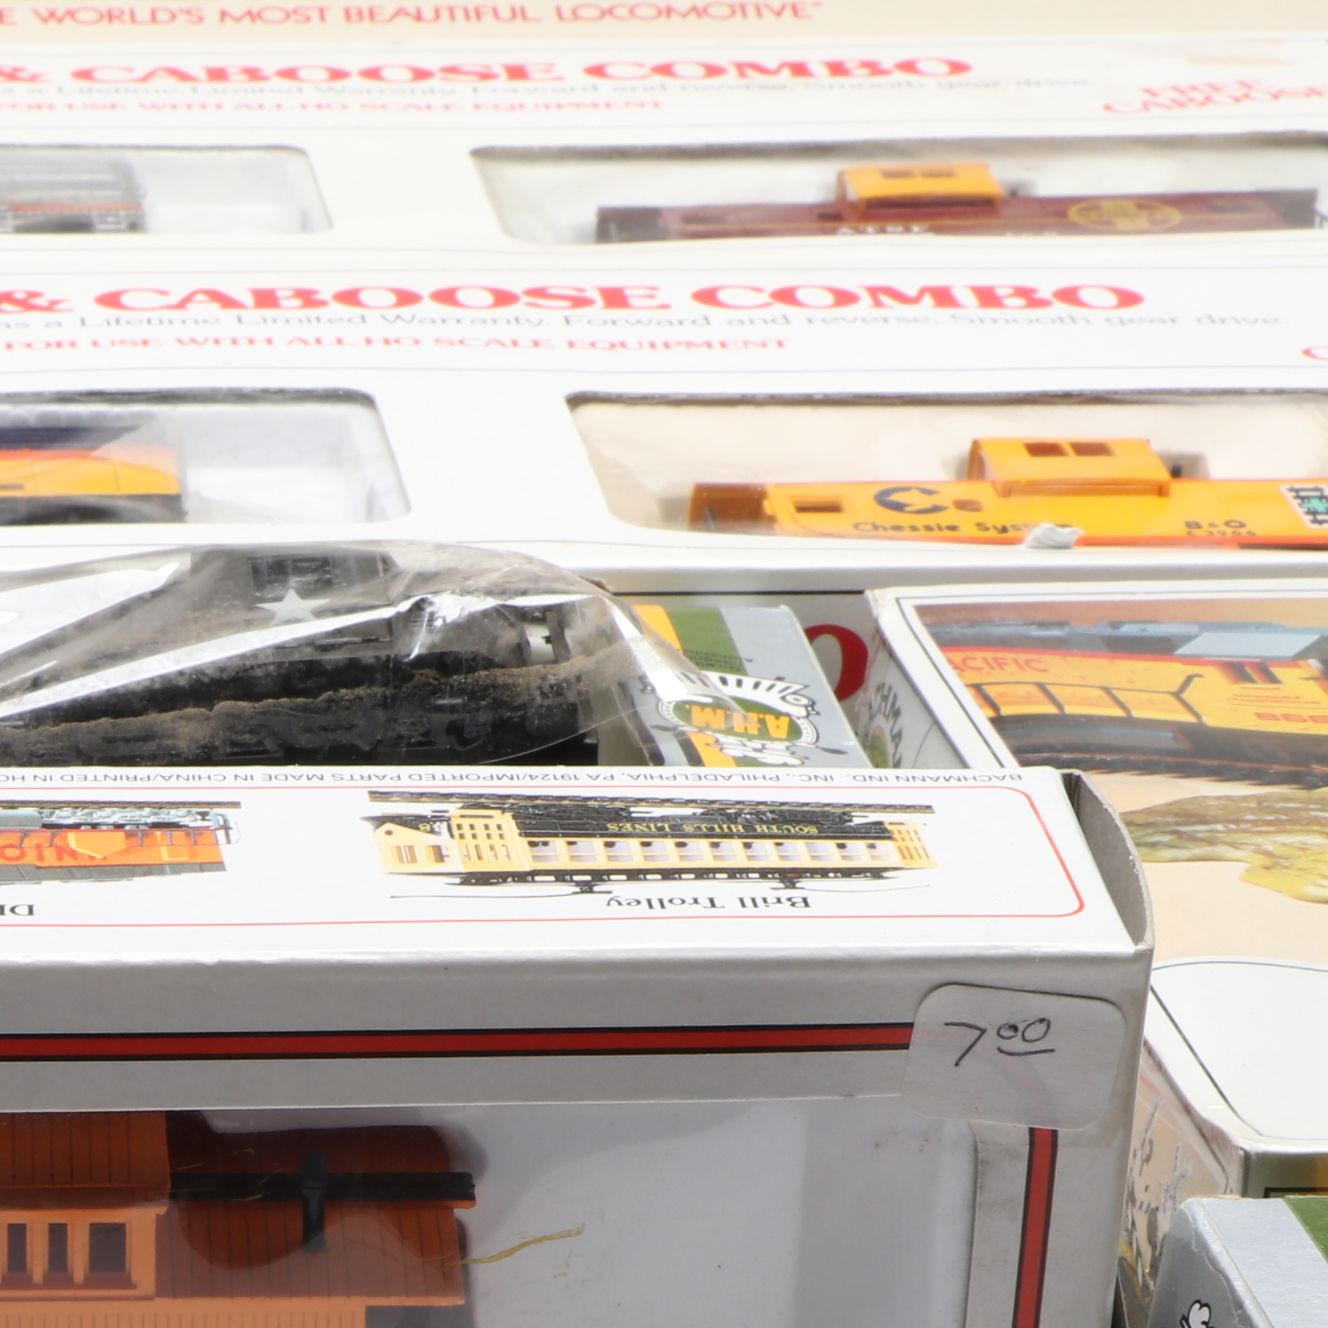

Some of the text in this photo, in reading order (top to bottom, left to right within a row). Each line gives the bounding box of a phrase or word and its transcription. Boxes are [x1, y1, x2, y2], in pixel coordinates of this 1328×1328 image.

[32, 6, 206, 26] WORLD'S
[218, 6, 328, 25] MOST
[343, 4, 542, 24] BEAUTIFUL
[70, 63, 565, 84] CABOOSE
[582, 57, 973, 81] COMBO
[92, 286, 672, 312] CABOOSE
[690, 284, 1145, 310] COMBO
[43, 321, 65, 330] a
[79, 315, 223, 328] Lifetime
[236, 314, 366, 327] Limited
[563, 313, 711, 328] Forward
[725, 313, 792, 327] and
[950, 312, 1092, 327] Smooth
[1104, 313, 1181, 329] gear
[4, 336, 792, 351] FOR USE WITH ALL HO SCALE EQUIPMENT
[32, 773, 55, 783] IN
[59, 773, 228, 783] CHINA/PRINTED
[233, 773, 255, 783] IN
[260, 773, 325, 783] MADE
[331, 773, 402, 783] PARTS
[408, 772, 581, 783] 19124/IMPORTED
[585, 772, 616, 783] PA
[620, 771, 781, 783] PHILADELPHIA,
[845, 772, 889, 783] IND.
[894, 772, 1023, 783] BACHMANN
[605, 820, 820, 835] SOUTH HILLS LINES
[603, 894, 812, 911] Brill Trolley
